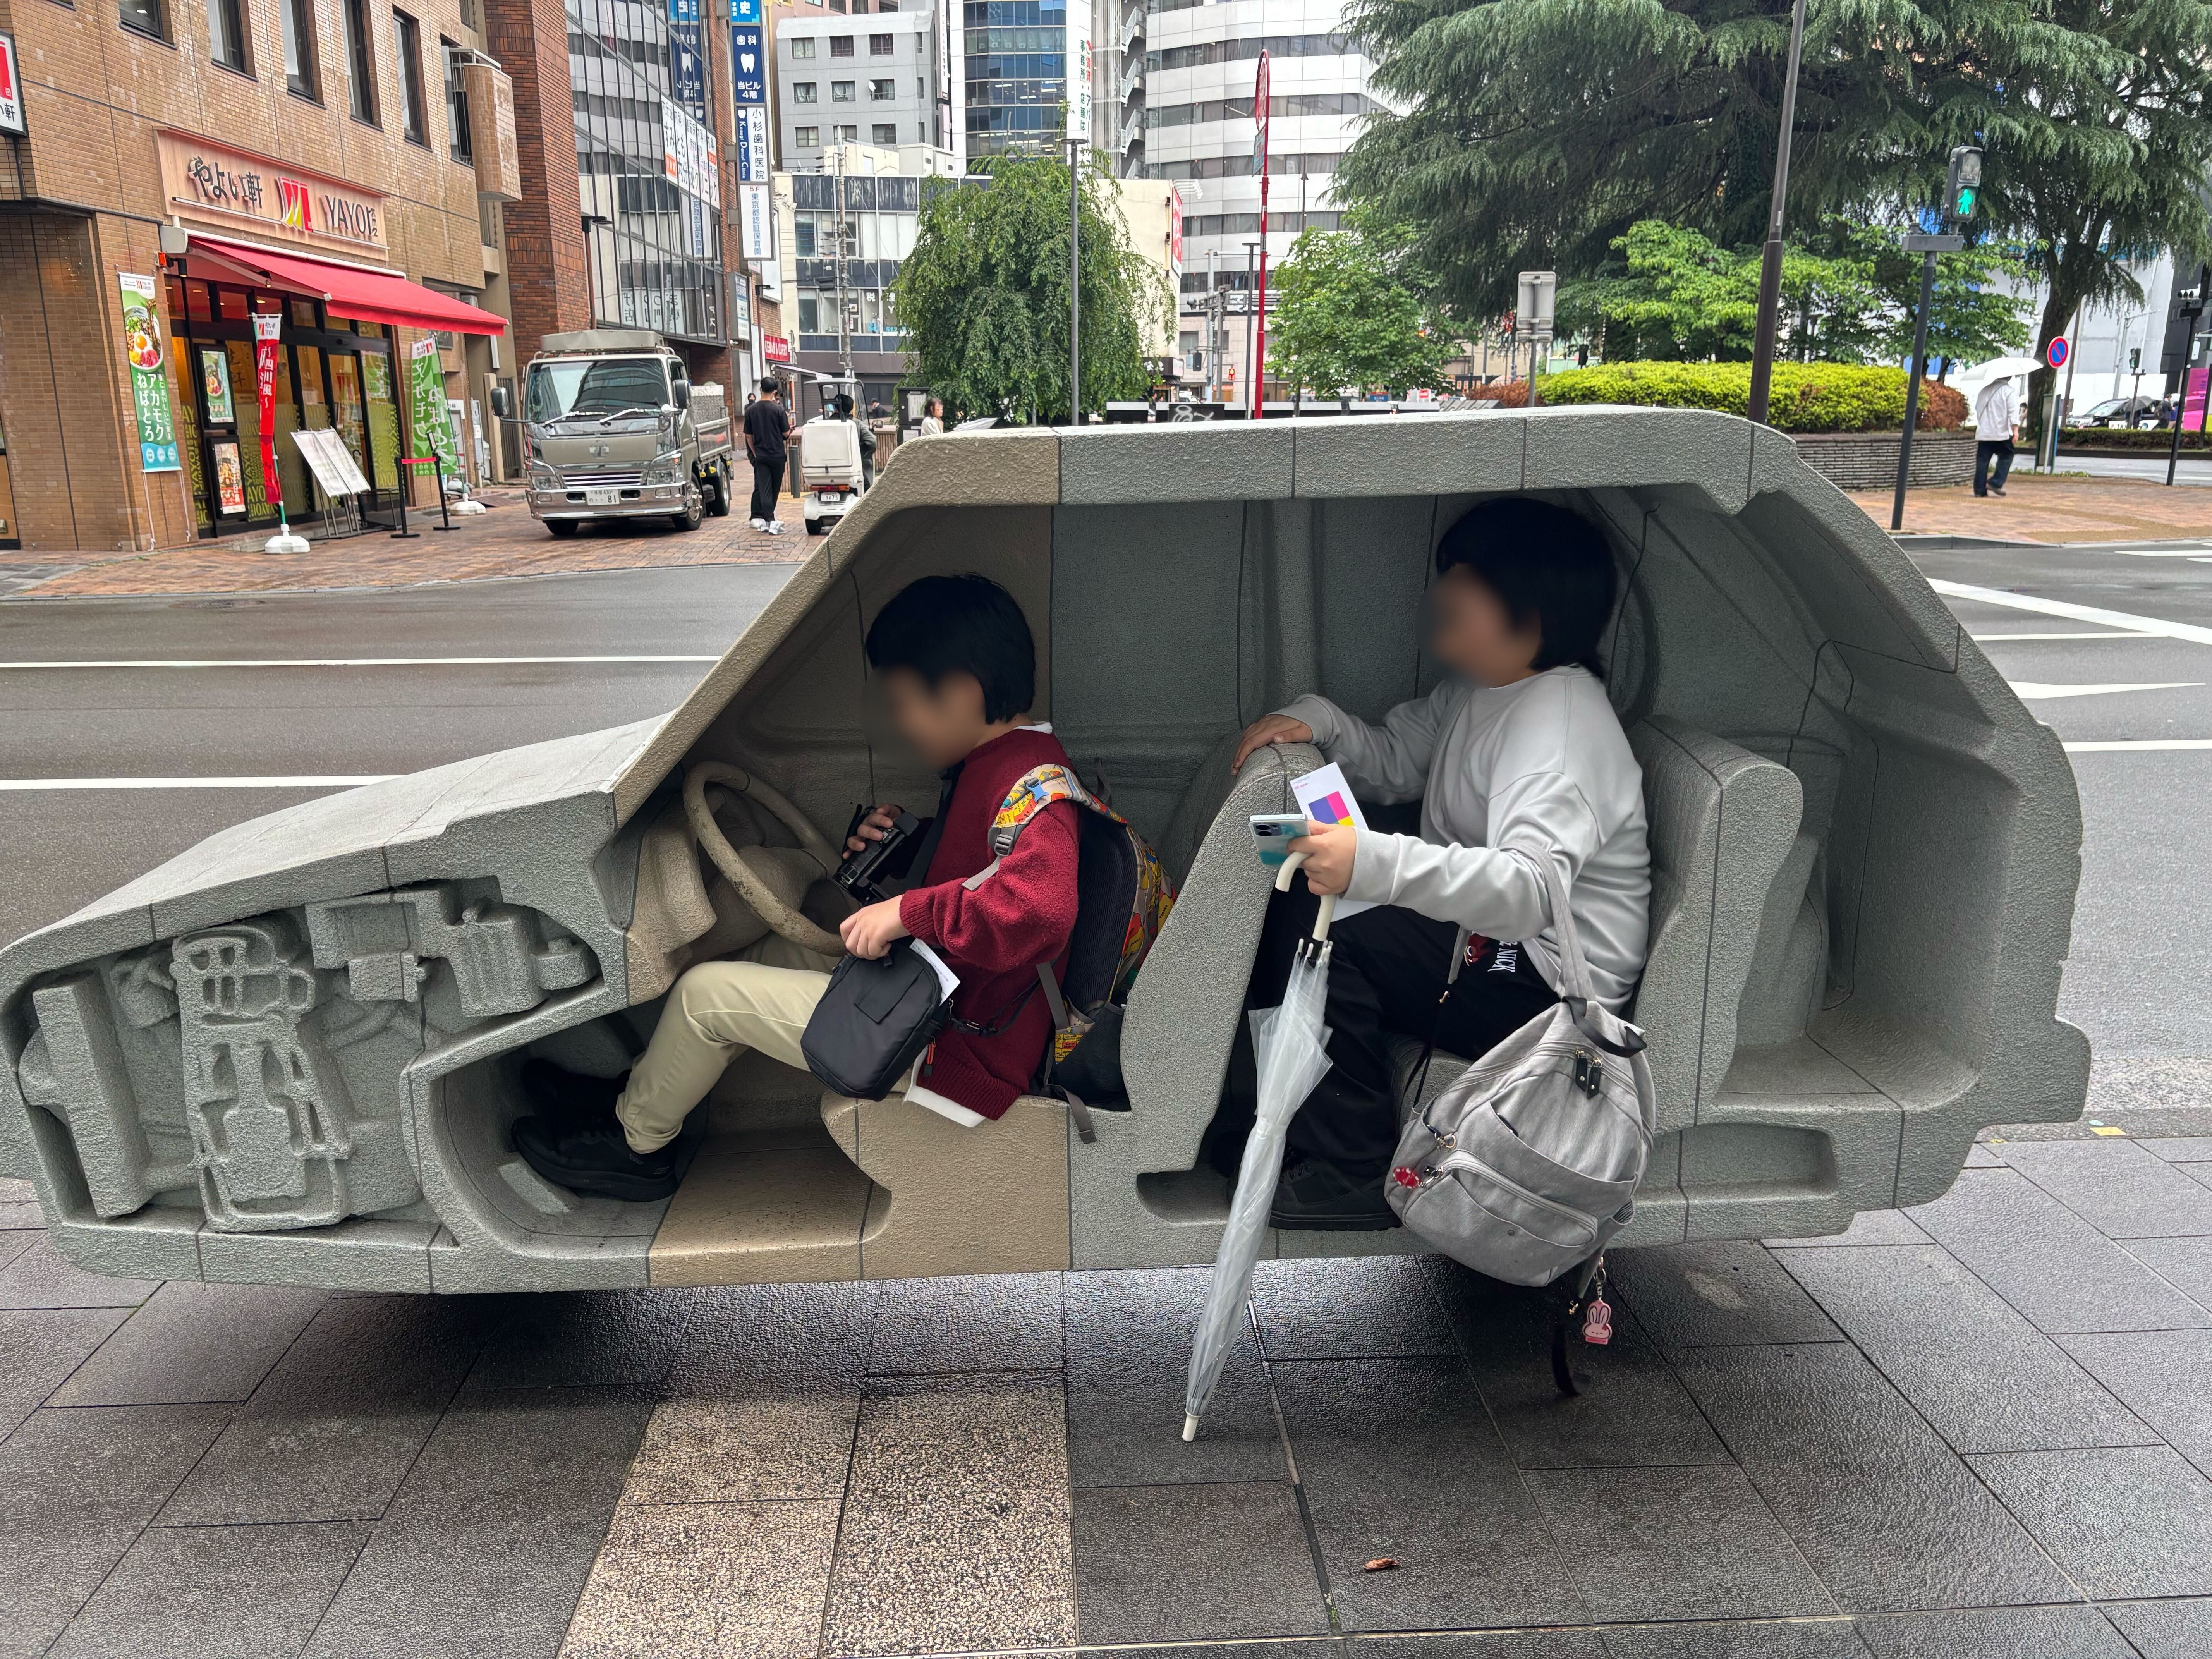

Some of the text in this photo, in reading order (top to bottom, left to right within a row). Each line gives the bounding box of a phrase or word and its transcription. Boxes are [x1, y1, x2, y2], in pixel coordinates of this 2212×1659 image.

[737, 35, 757, 45] 歯科
[738, 81, 761, 90] 当ビル
[752, 109, 765, 179] 小杉歯科医院
[193, 156, 263, 204] やよい軒
[325, 195, 372, 235] YAYOI
[137, 372, 154, 441] ねばとろ
[147, 373, 164, 441] アカモク
[1487, 948, 1518, 973] NICK
